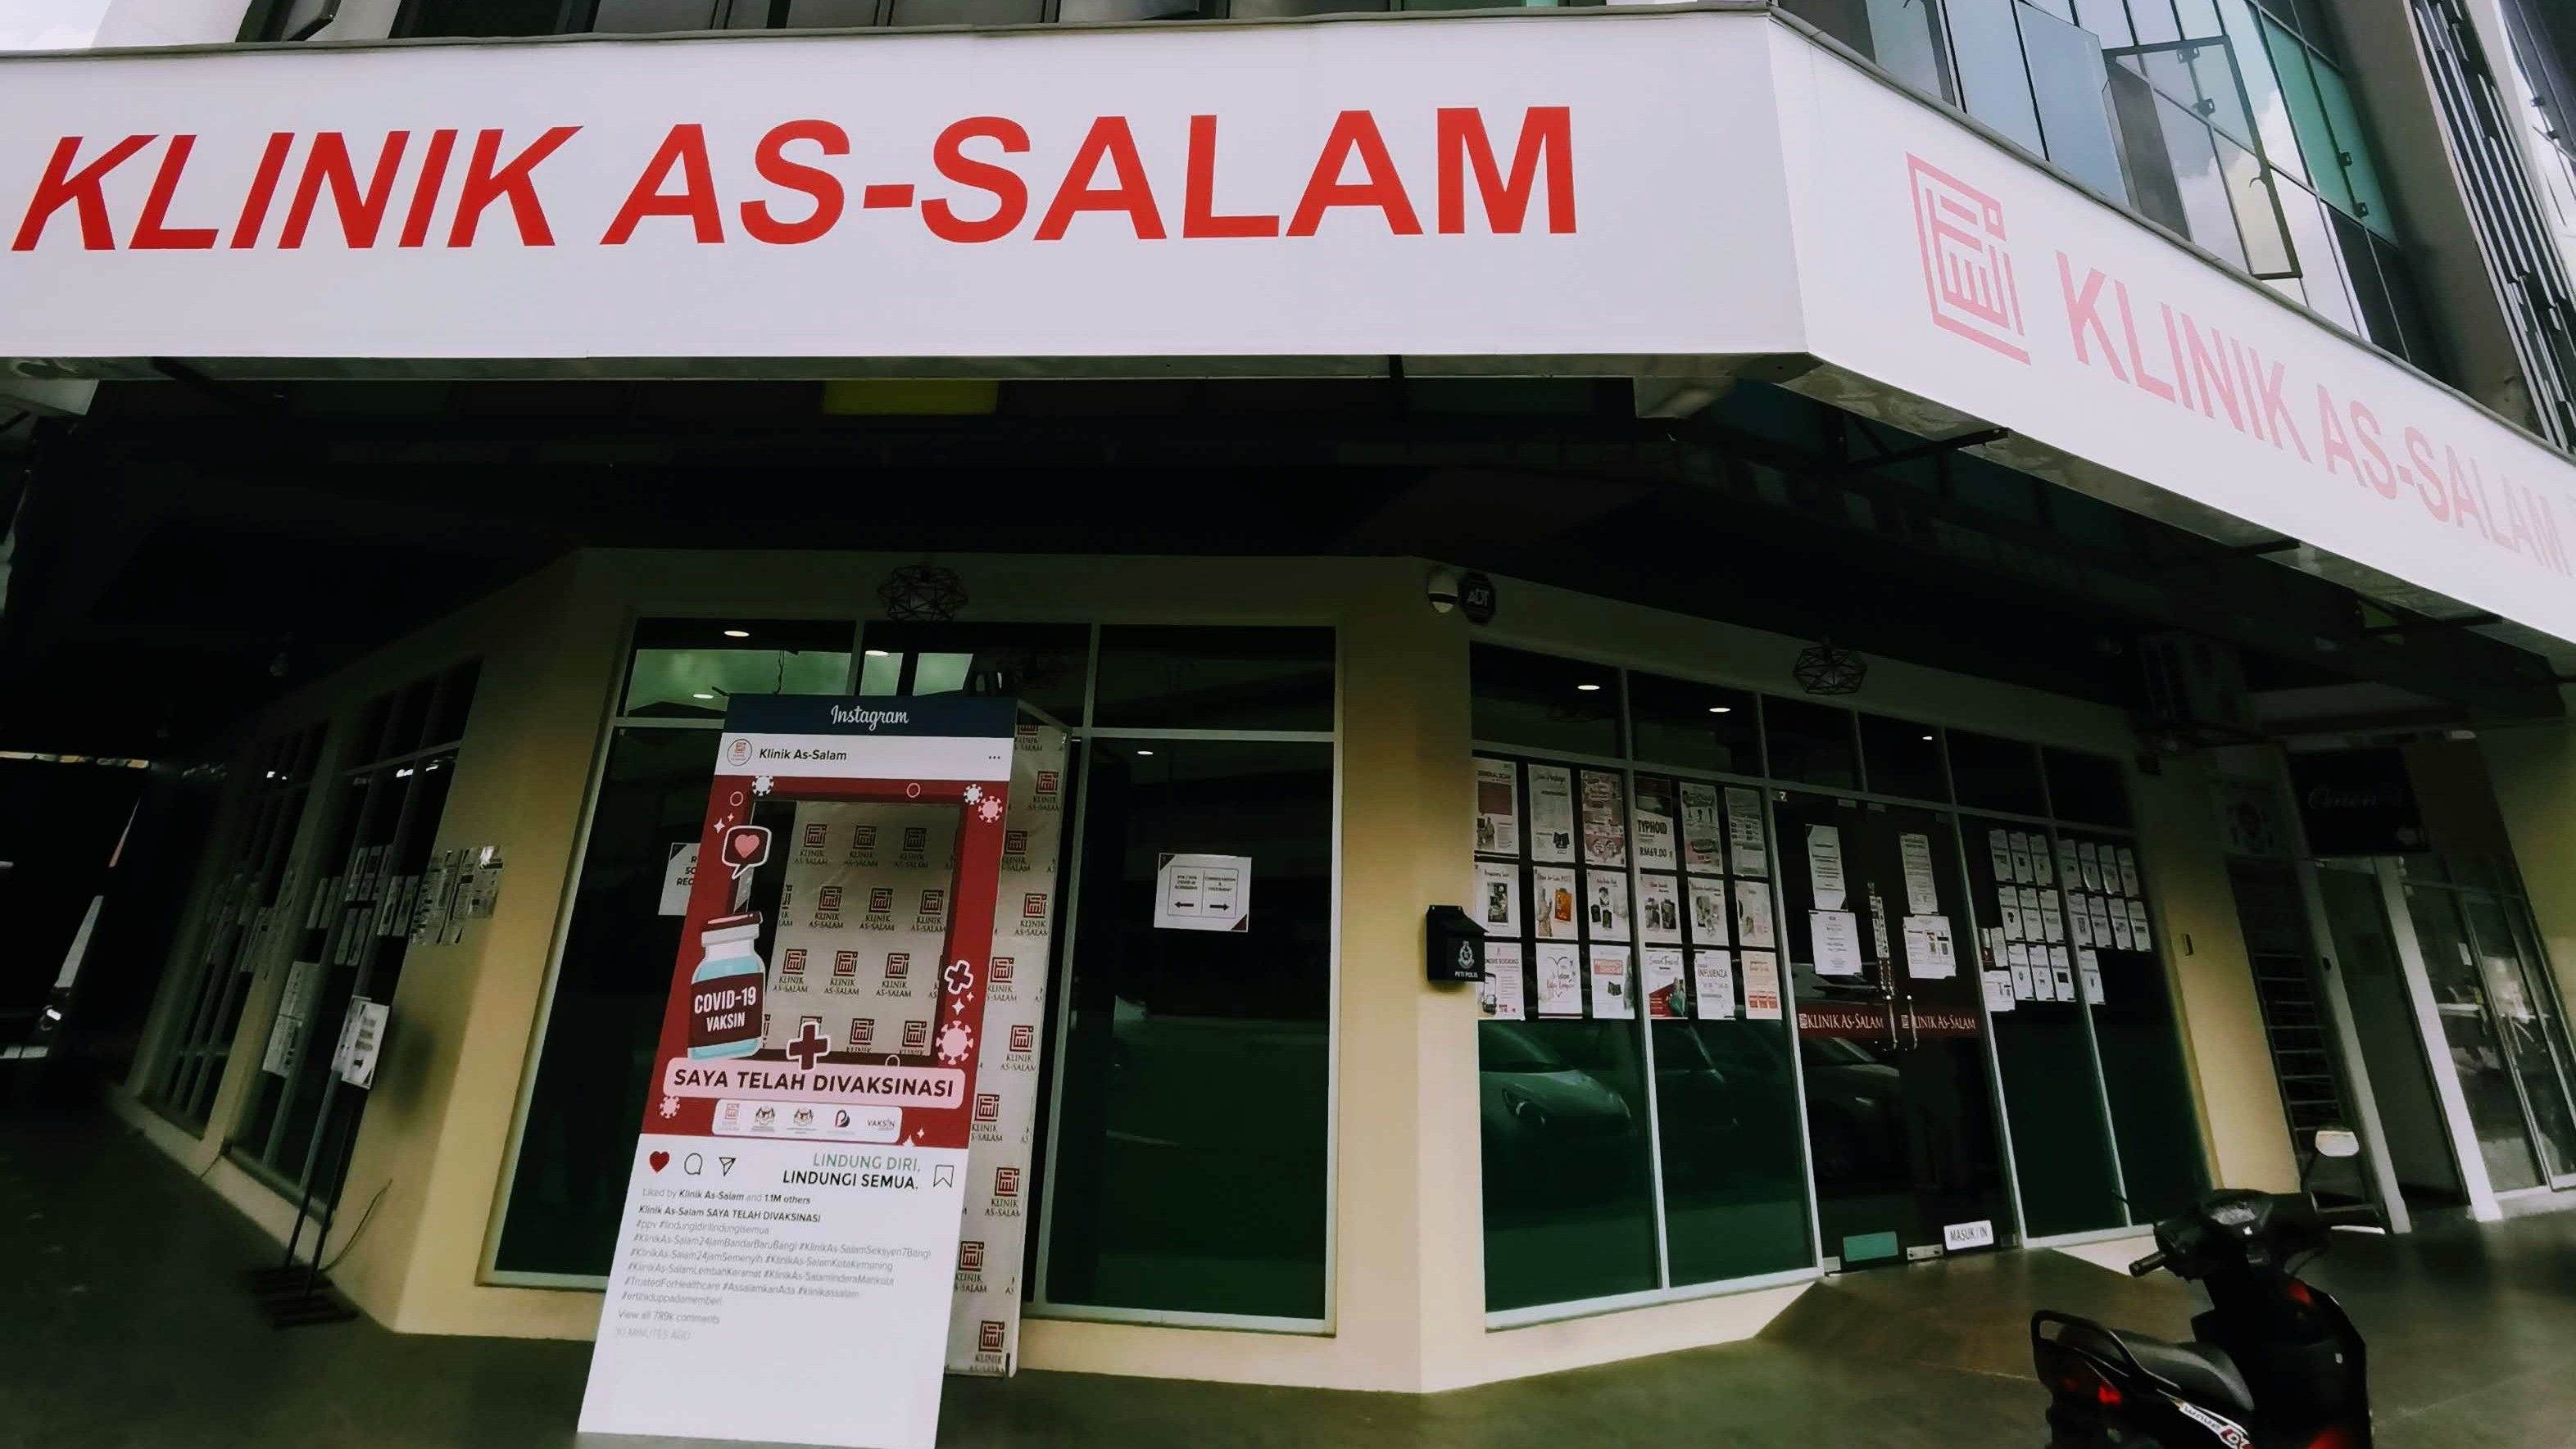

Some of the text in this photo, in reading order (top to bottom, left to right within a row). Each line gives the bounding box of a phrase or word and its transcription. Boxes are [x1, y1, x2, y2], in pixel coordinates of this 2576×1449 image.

[11, 106, 1577, 251] KLINIK AS-SALAM
[2056, 250, 2574, 579] KLINIK AS-SALAM
[1467, 588, 1490, 606] ADT
[831, 705, 909, 731] Instagram
[760, 749, 791, 759] Klinik
[794, 749, 847, 761] As-Salam
[1638, 820, 1667, 834] TYPHOID
[800, 849, 824, 858] KLINIK
[814, 912, 840, 921] KLINIK
[865, 914, 891, 922] KLINIK
[1698, 968, 1728, 978] INFLUENZA
[830, 978, 855, 986] KLINIK
[882, 980, 907, 989] KLINIK
[694, 985, 756, 1013] COVID-19
[706, 1012, 746, 1033] VAKSIN
[1807, 1012, 1884, 1030] KLINIK AS-SALAM
[1912, 1014, 1977, 1030] LINIK AS-SALAM
[1006, 1053, 1032, 1062] KLINIK
[674, 1068, 954, 1097] SAYA TELAH DIVAKSINASI
[972, 1124, 997, 1132] KLINIK
[971, 1133, 1003, 1142] S-SALAM
[813, 1152, 882, 1169] LINDUNG
[782, 1170, 856, 1186] LINDUNGI
[642, 1188, 664, 1197] Liked
[667, 1189, 678, 1199] by
[679, 1189, 702, 1198] Klinik
[705, 1191, 744, 1201] As-Salam
[783, 1196, 811, 1205] others
[991, 1198, 1018, 1207] KLINIK
[638, 1205, 821, 1223] Klinik As-Salam SAYA TELAH DIVAKSINASI
[955, 1284, 987, 1293] S-SALAM
[619, 1310, 639, 1320] View
[641, 1311, 651, 1320] all
[676, 1314, 720, 1324] comments
